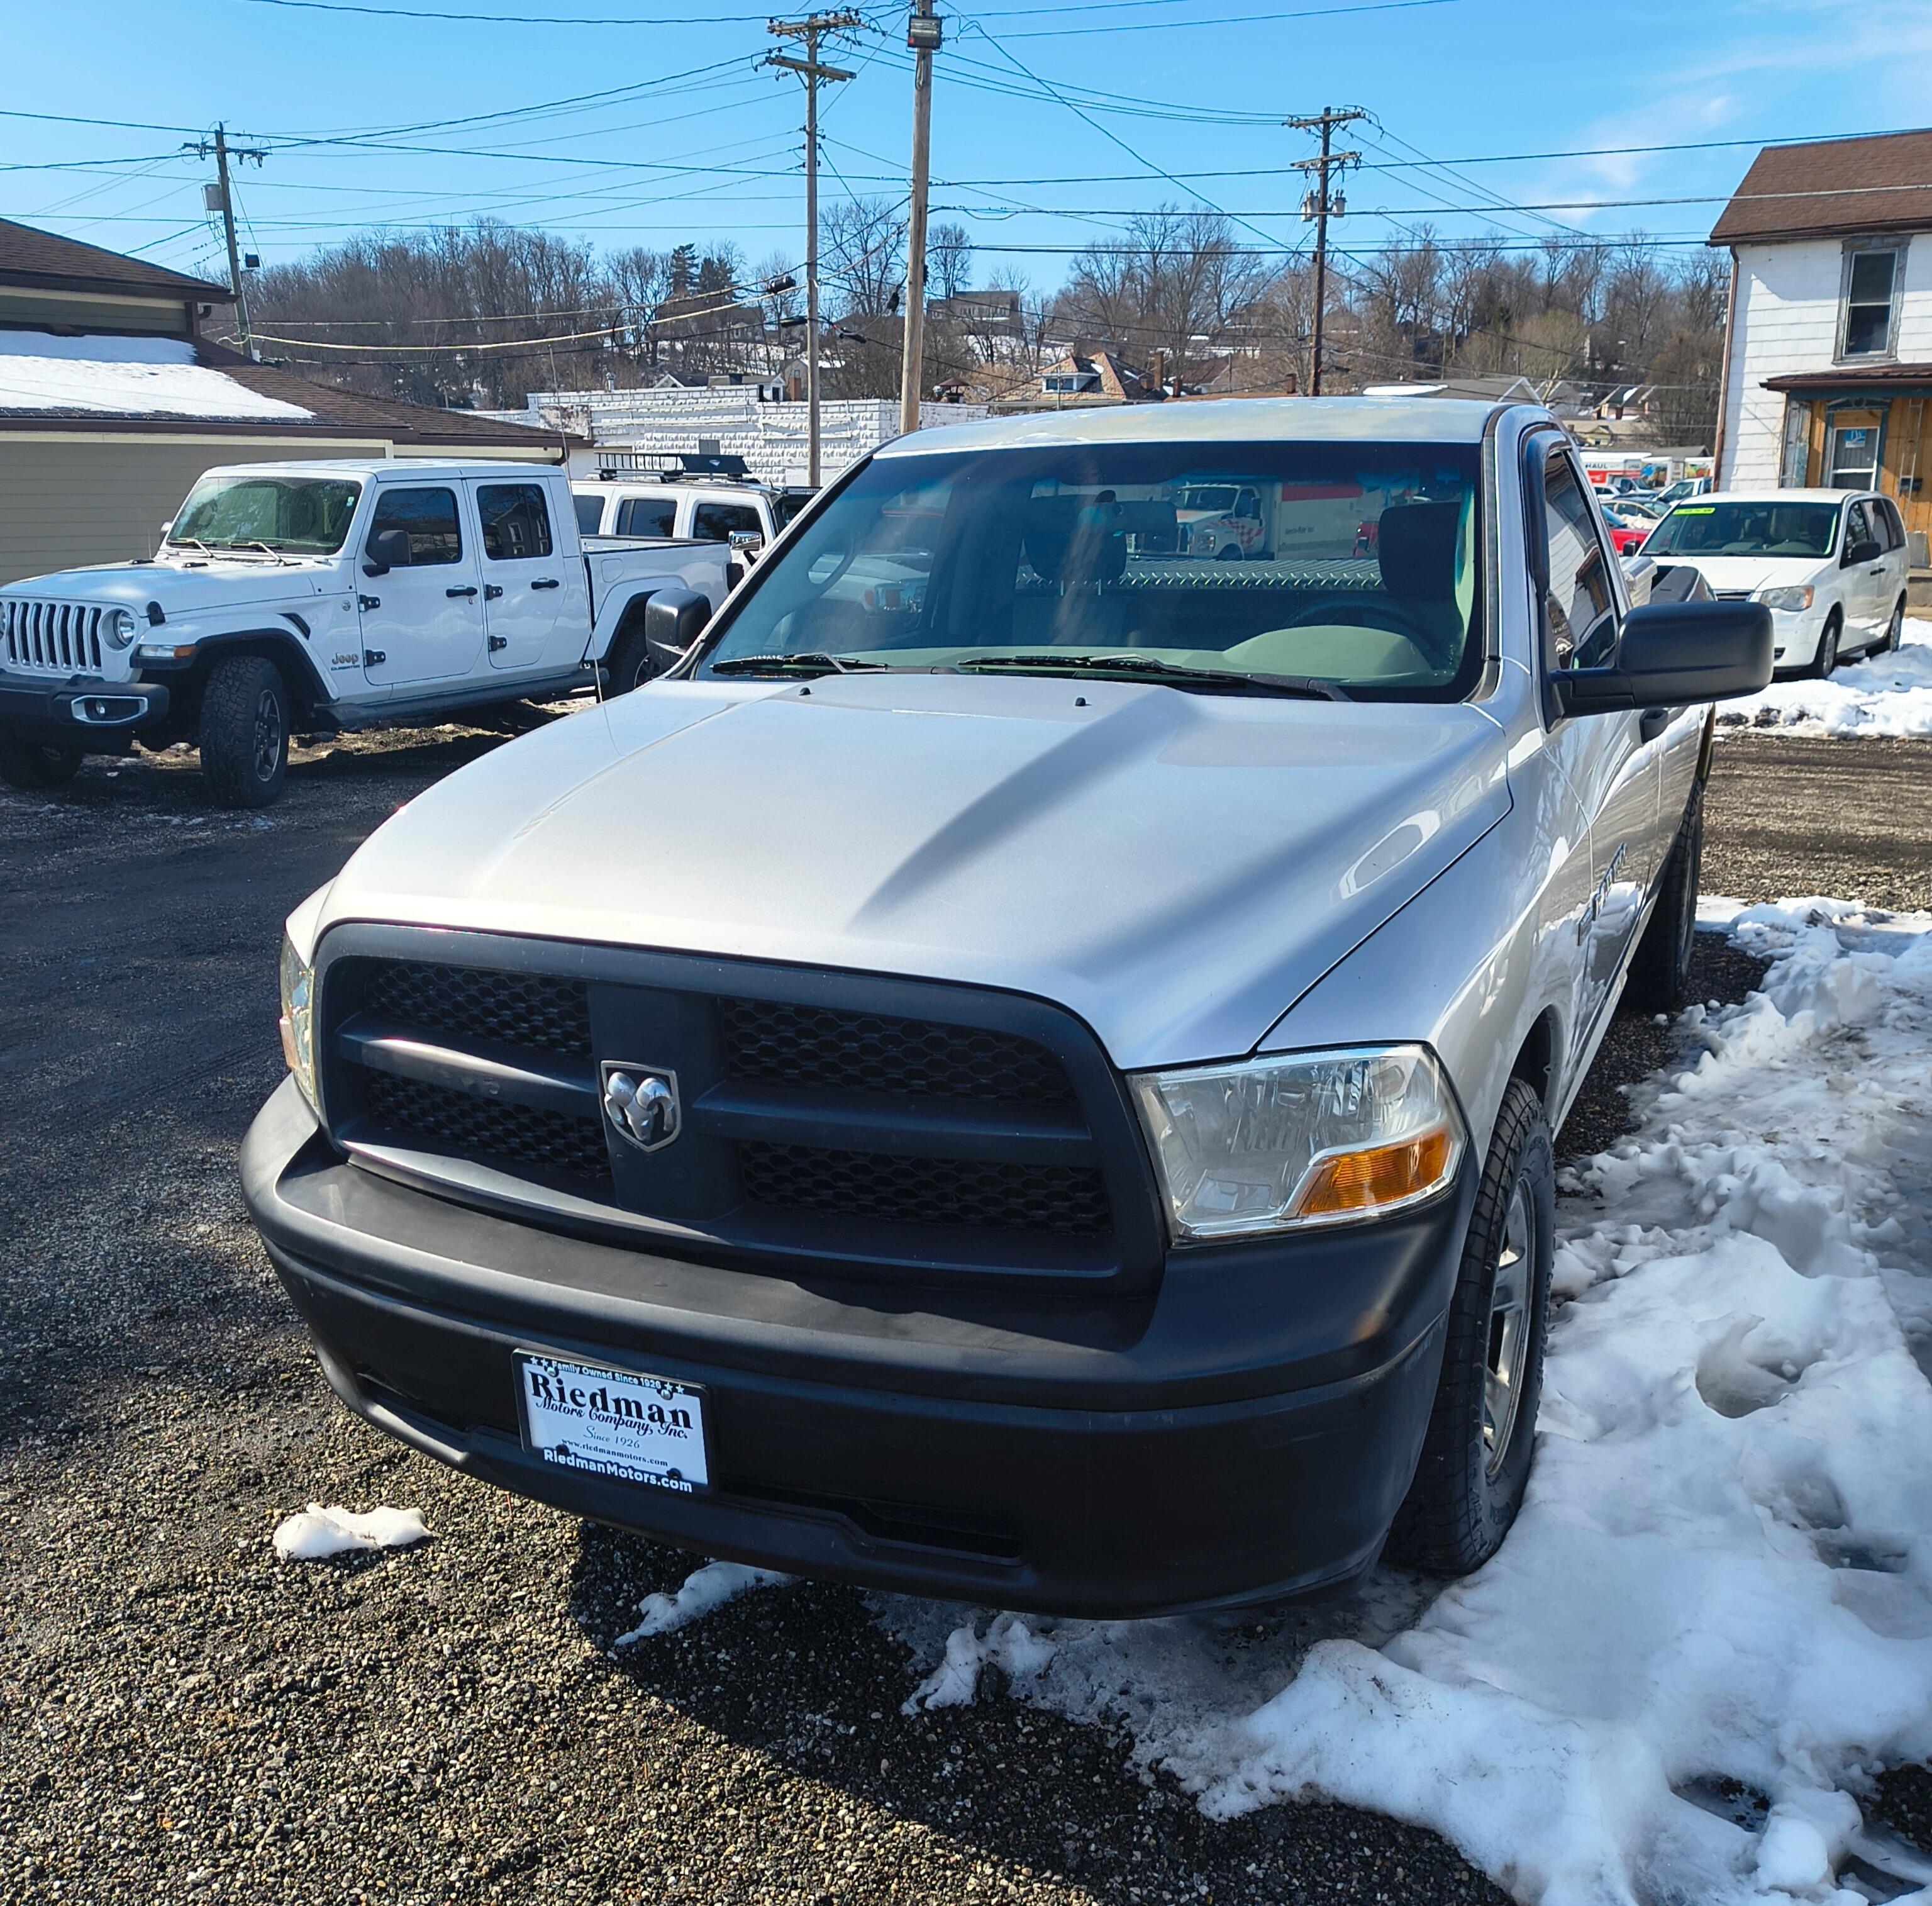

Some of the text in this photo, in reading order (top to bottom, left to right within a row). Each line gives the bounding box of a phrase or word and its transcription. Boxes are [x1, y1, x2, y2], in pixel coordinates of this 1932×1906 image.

[332, 652, 358, 664] Jeep
[552, 1361, 662, 1389] Family Owned Since 1926
[528, 1371, 693, 1429] Riedman
[536, 1396, 688, 1439] Motors Company, Inc.
[583, 1425, 640, 1449] Since 1926
[562, 1439, 668, 1467] www.riedmanmotors.com
[543, 1449, 692, 1493] RiedmanMotors.com
